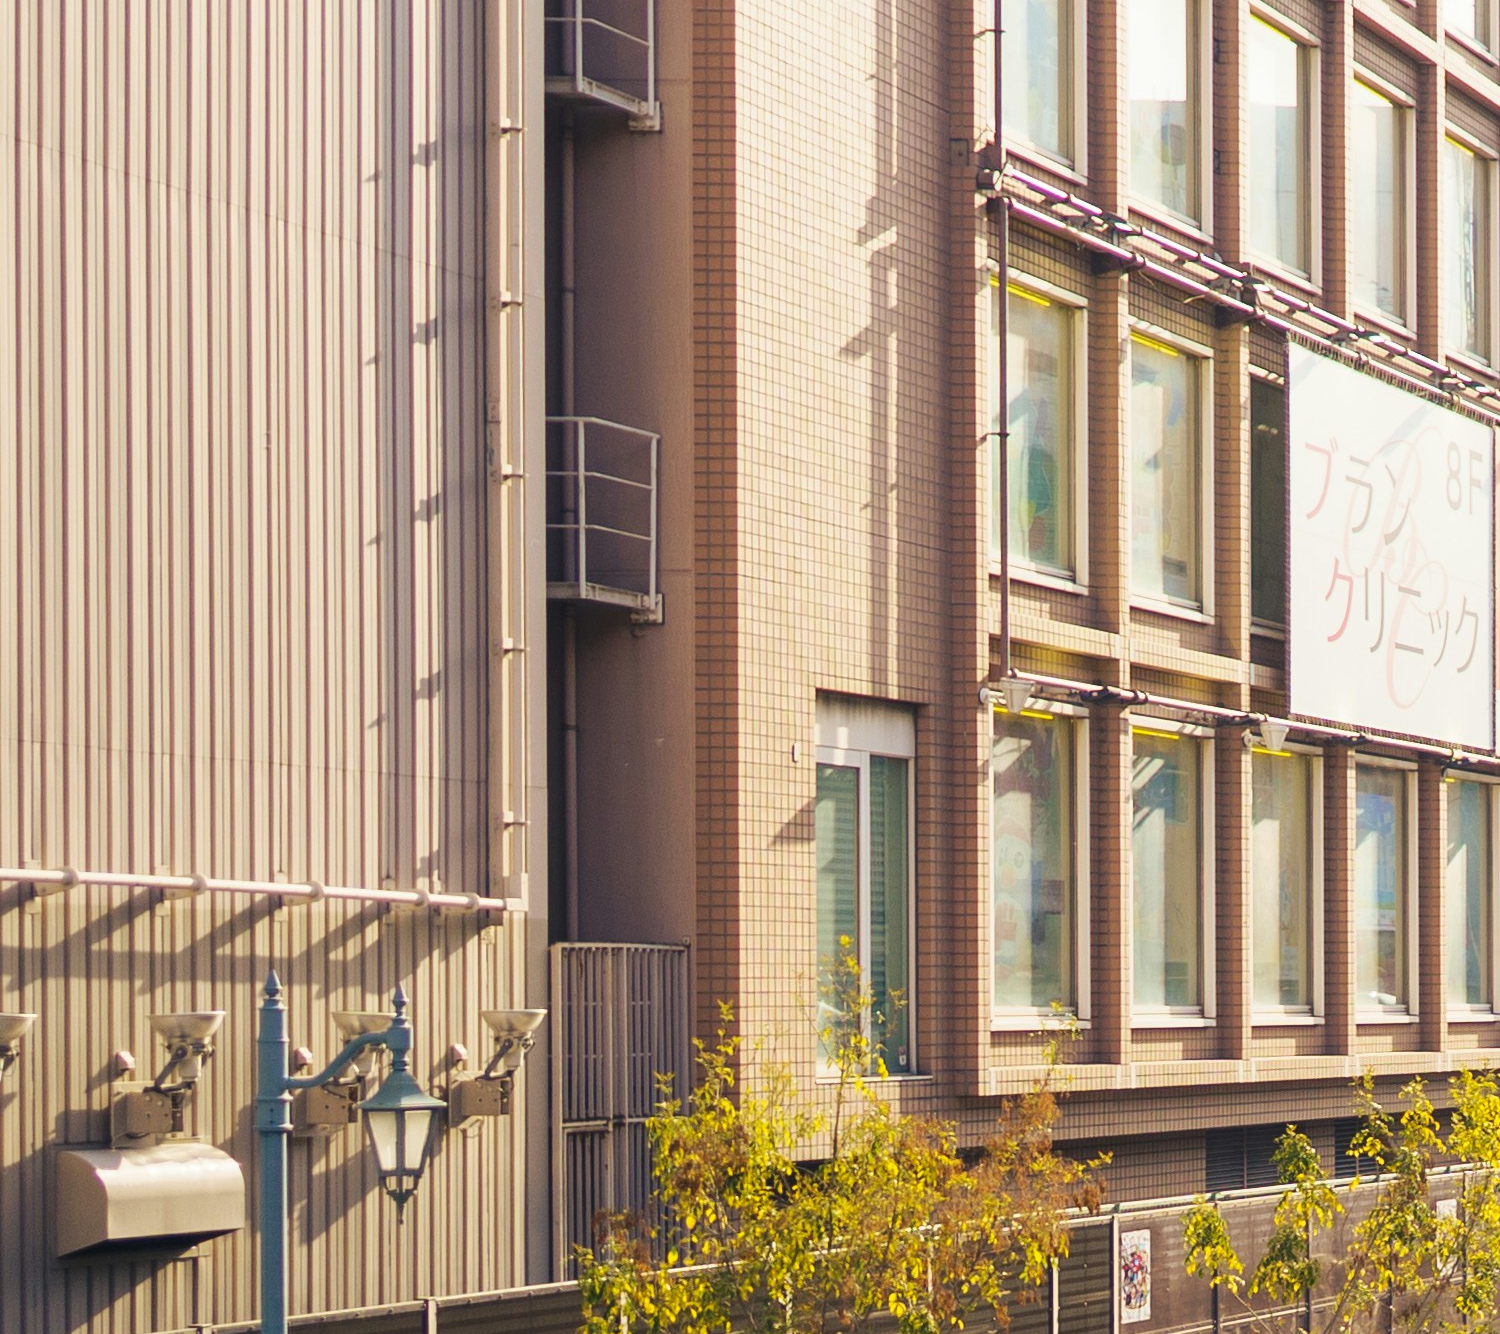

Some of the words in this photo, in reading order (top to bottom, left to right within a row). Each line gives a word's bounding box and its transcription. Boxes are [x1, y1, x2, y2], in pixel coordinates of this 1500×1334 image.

[1305, 436, 1412, 546] ブラン
[1446, 441, 1483, 515] 8F
[1325, 556, 1479, 673] クリニック
